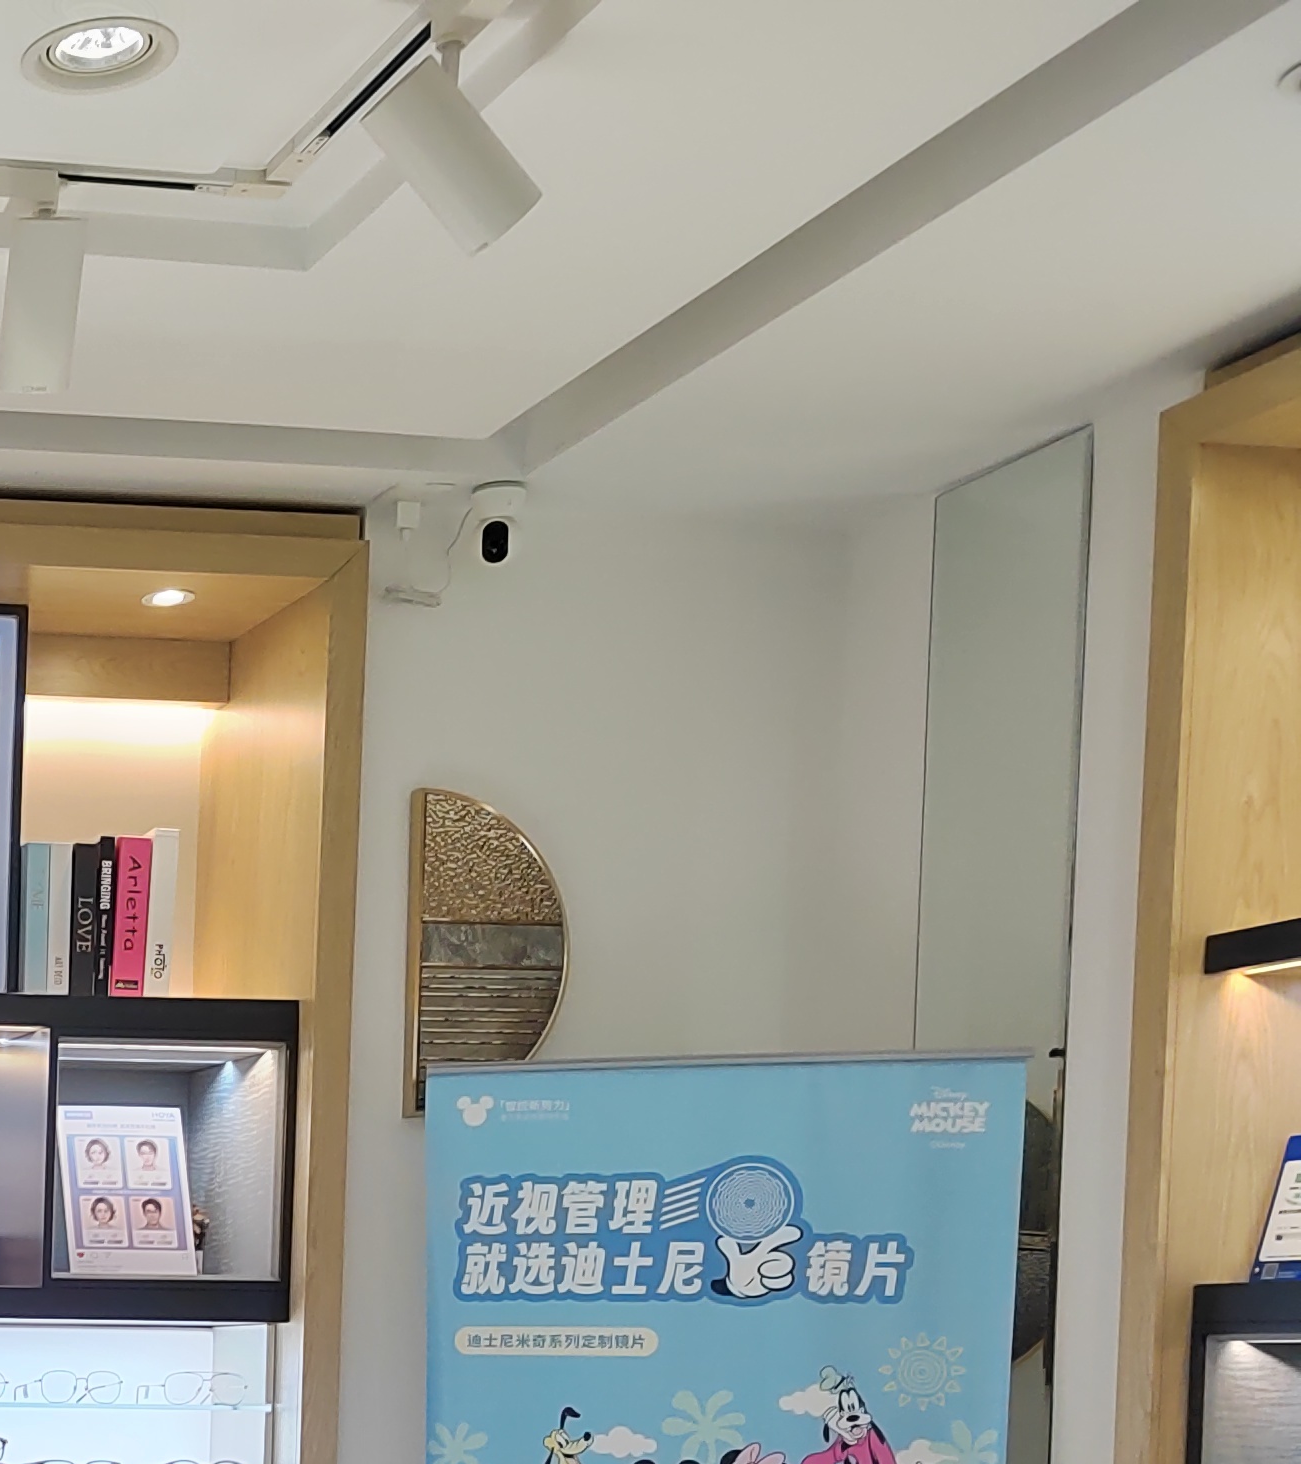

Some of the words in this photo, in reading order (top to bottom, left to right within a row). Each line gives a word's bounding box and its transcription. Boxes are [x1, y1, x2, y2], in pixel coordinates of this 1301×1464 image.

[99, 860, 113, 910] BRINGING
[123, 855, 143, 951] Arletta
[76, 897, 94, 952] LOVE
[910, 1101, 991, 1117] MICKEY
[910, 1117, 986, 1133] MOUSE
[463, 1179, 658, 1236] 近视管理
[460, 1240, 706, 1296] 就选迪士尼
[805, 1240, 906, 1297] 镜片
[467, 1333, 647, 1351] 迪士尼米奇系列定制镜片
